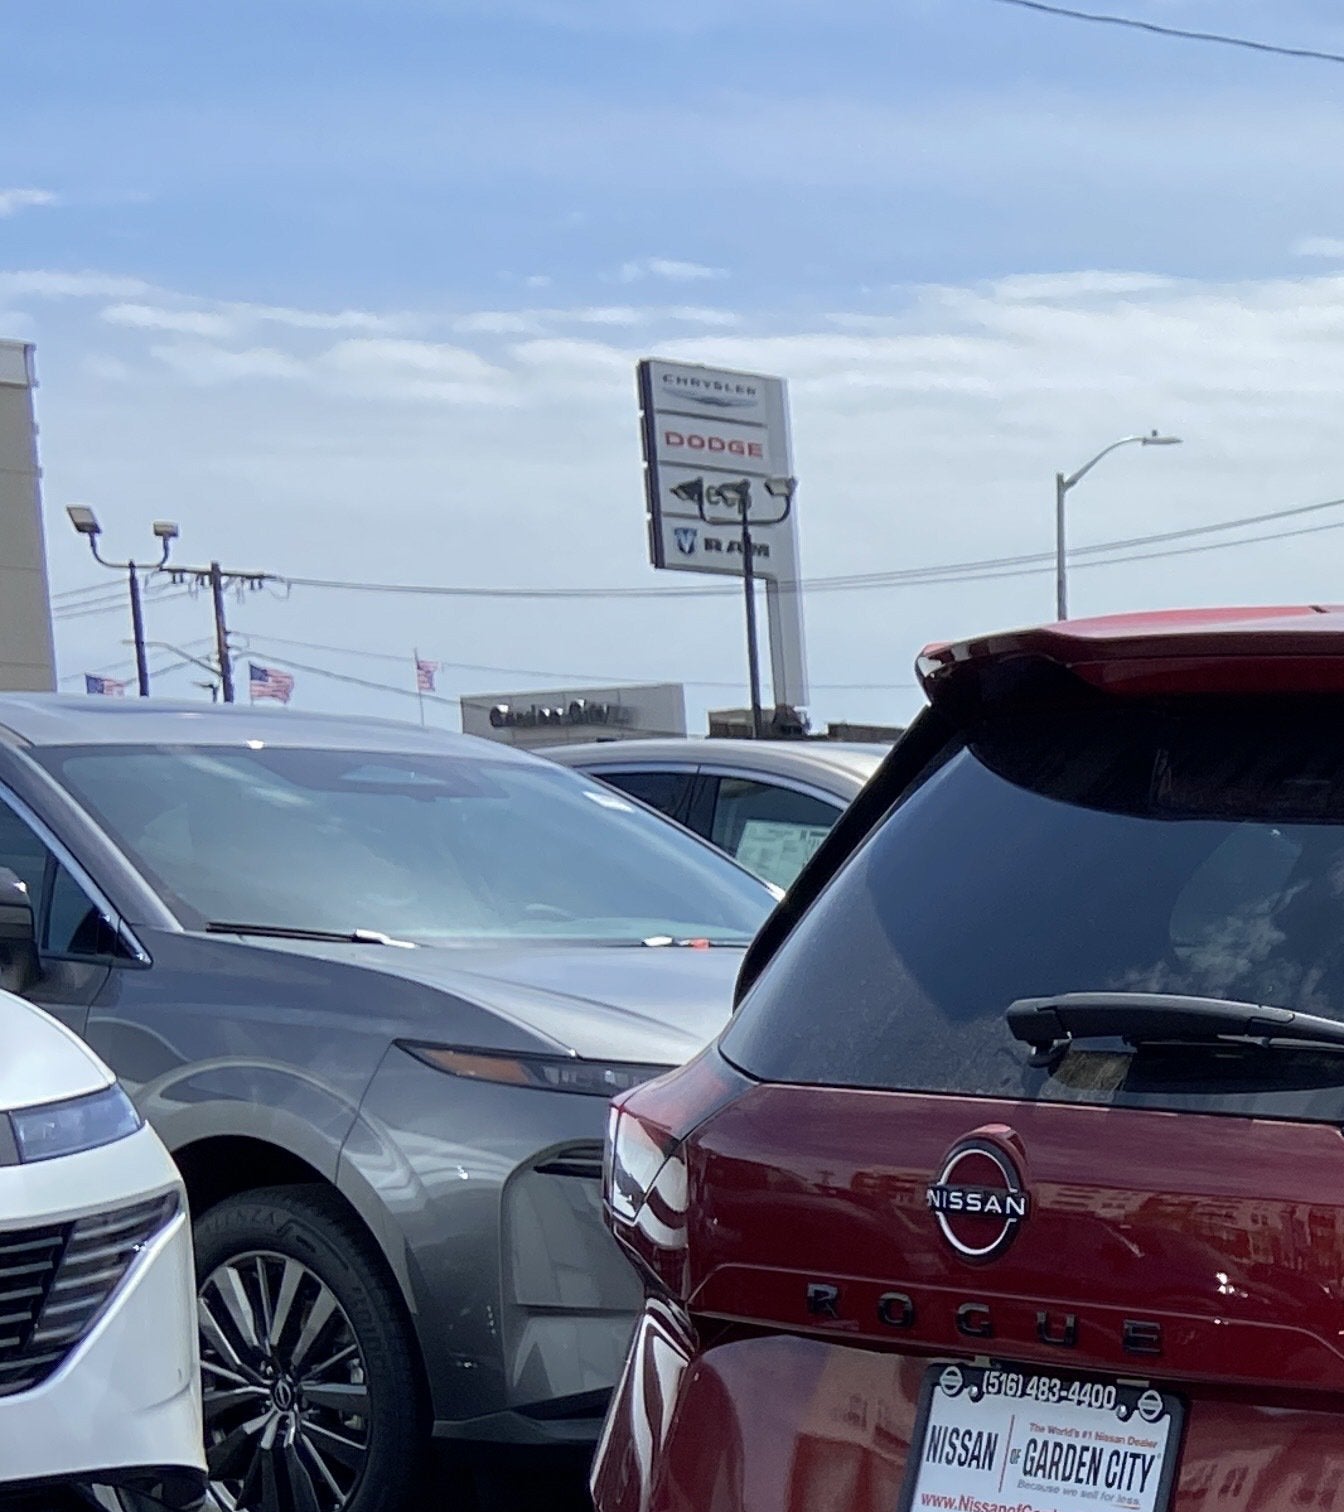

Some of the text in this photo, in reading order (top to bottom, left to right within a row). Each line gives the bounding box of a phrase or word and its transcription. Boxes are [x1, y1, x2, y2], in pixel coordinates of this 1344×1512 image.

[662, 374, 757, 395] CHRYSLER
[664, 431, 764, 458] DODGE
[928, 1188, 1025, 1215] NISSAN
[806, 1282, 1164, 1354] ROGUE
[982, 1370, 1117, 1409] (516) 483-4400
[925, 1424, 1157, 1494] NISSAN OF GARDEN CITY
